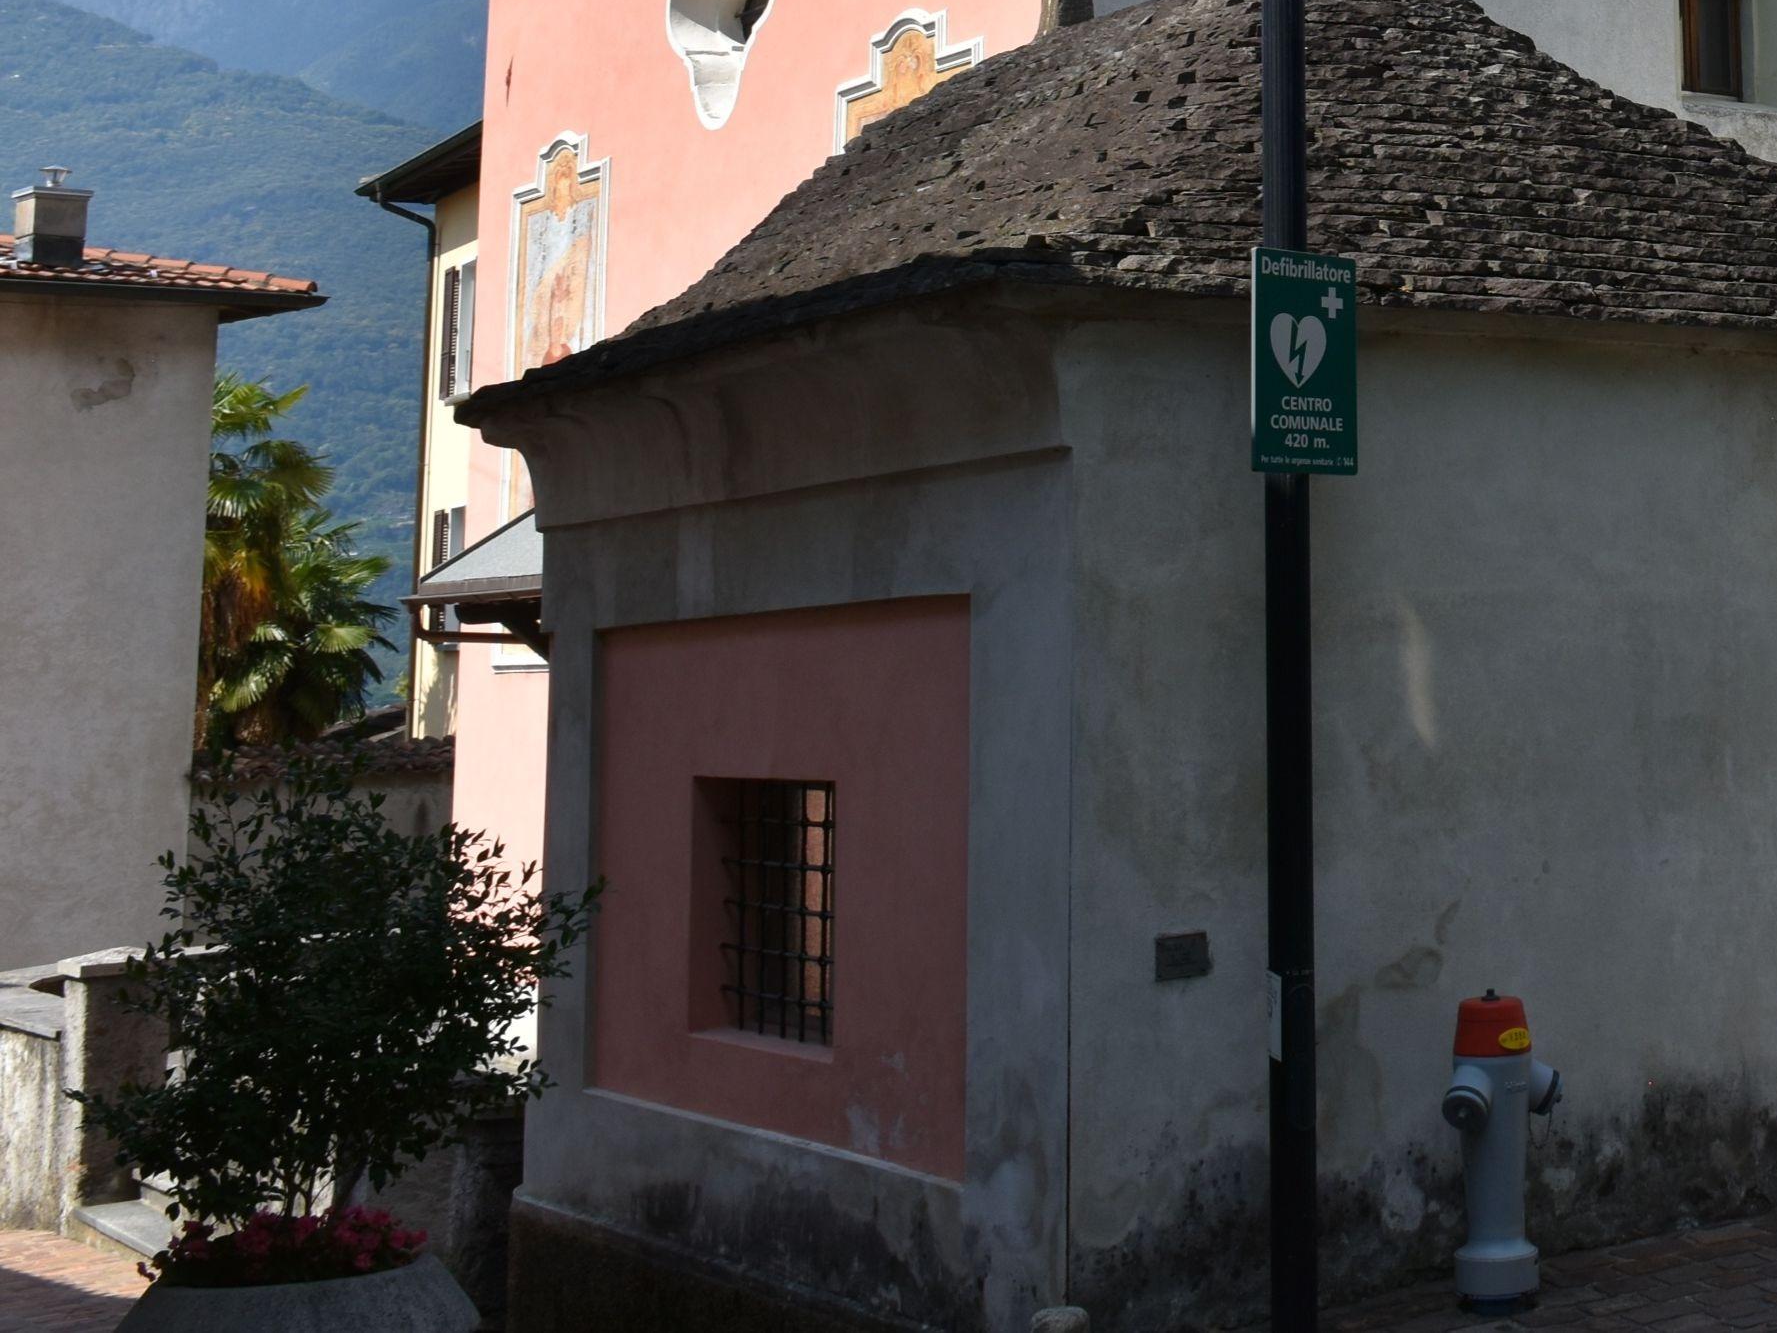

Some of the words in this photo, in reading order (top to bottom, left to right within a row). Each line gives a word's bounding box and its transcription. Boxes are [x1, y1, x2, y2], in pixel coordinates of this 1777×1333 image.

[1261, 256, 1351, 284] Defibrillatore
[1281, 395, 1332, 412] CENTRO
[1271, 414, 1343, 431] COMUNALE
[1284, 433, 1308, 448] 420
[1313, 437, 1330, 449] m.
